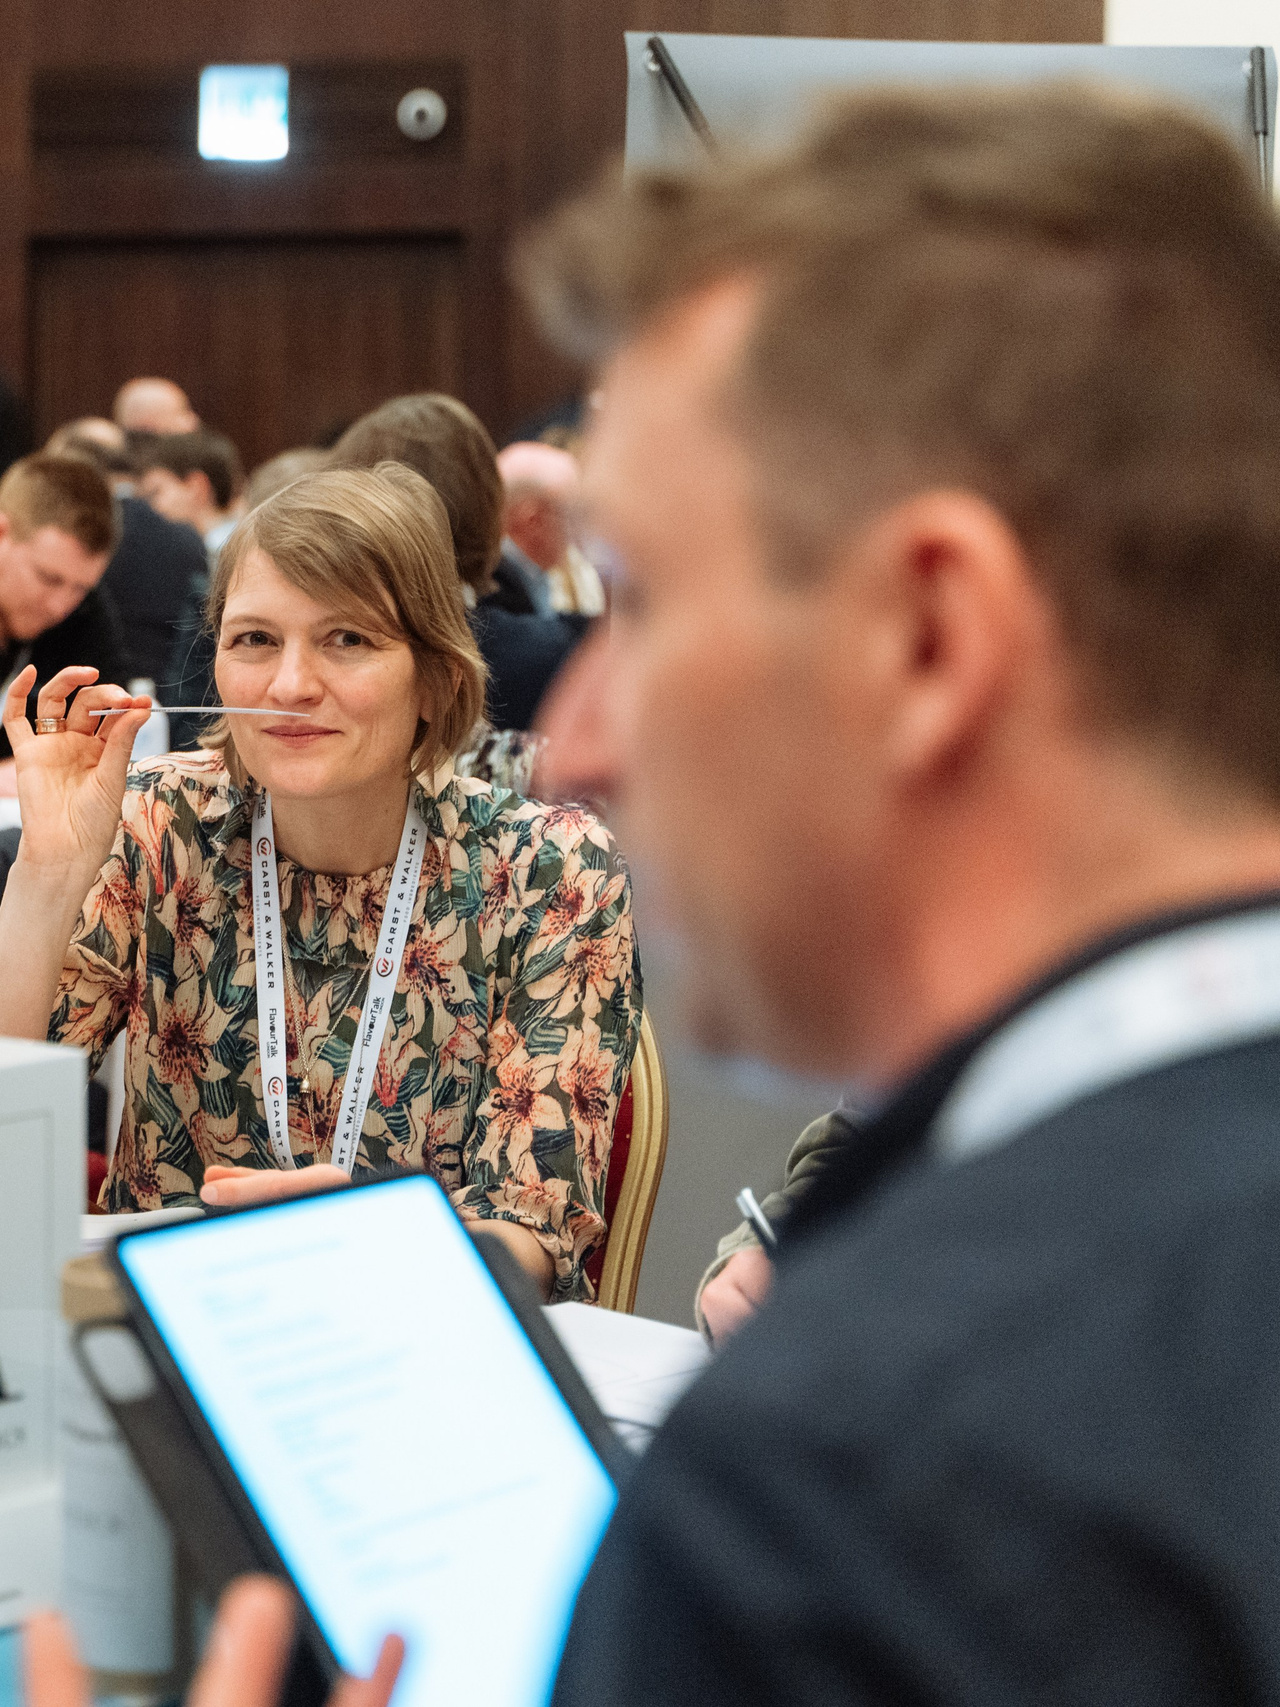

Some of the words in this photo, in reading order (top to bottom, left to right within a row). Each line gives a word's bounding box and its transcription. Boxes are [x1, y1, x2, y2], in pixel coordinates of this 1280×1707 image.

[400, 828, 419, 885] WALKER
[262, 860, 271, 908] CARST
[398, 892, 404, 900] &
[264, 915, 272, 924] &
[385, 907, 401, 954] CARST
[265, 930, 275, 989] WALKER
[269, 1008, 278, 1058] FlavourTalk
[363, 996, 382, 1048] FlavourTalk
[345, 1065, 365, 1125] WALKER
[274, 1100, 284, 1148] CARST
